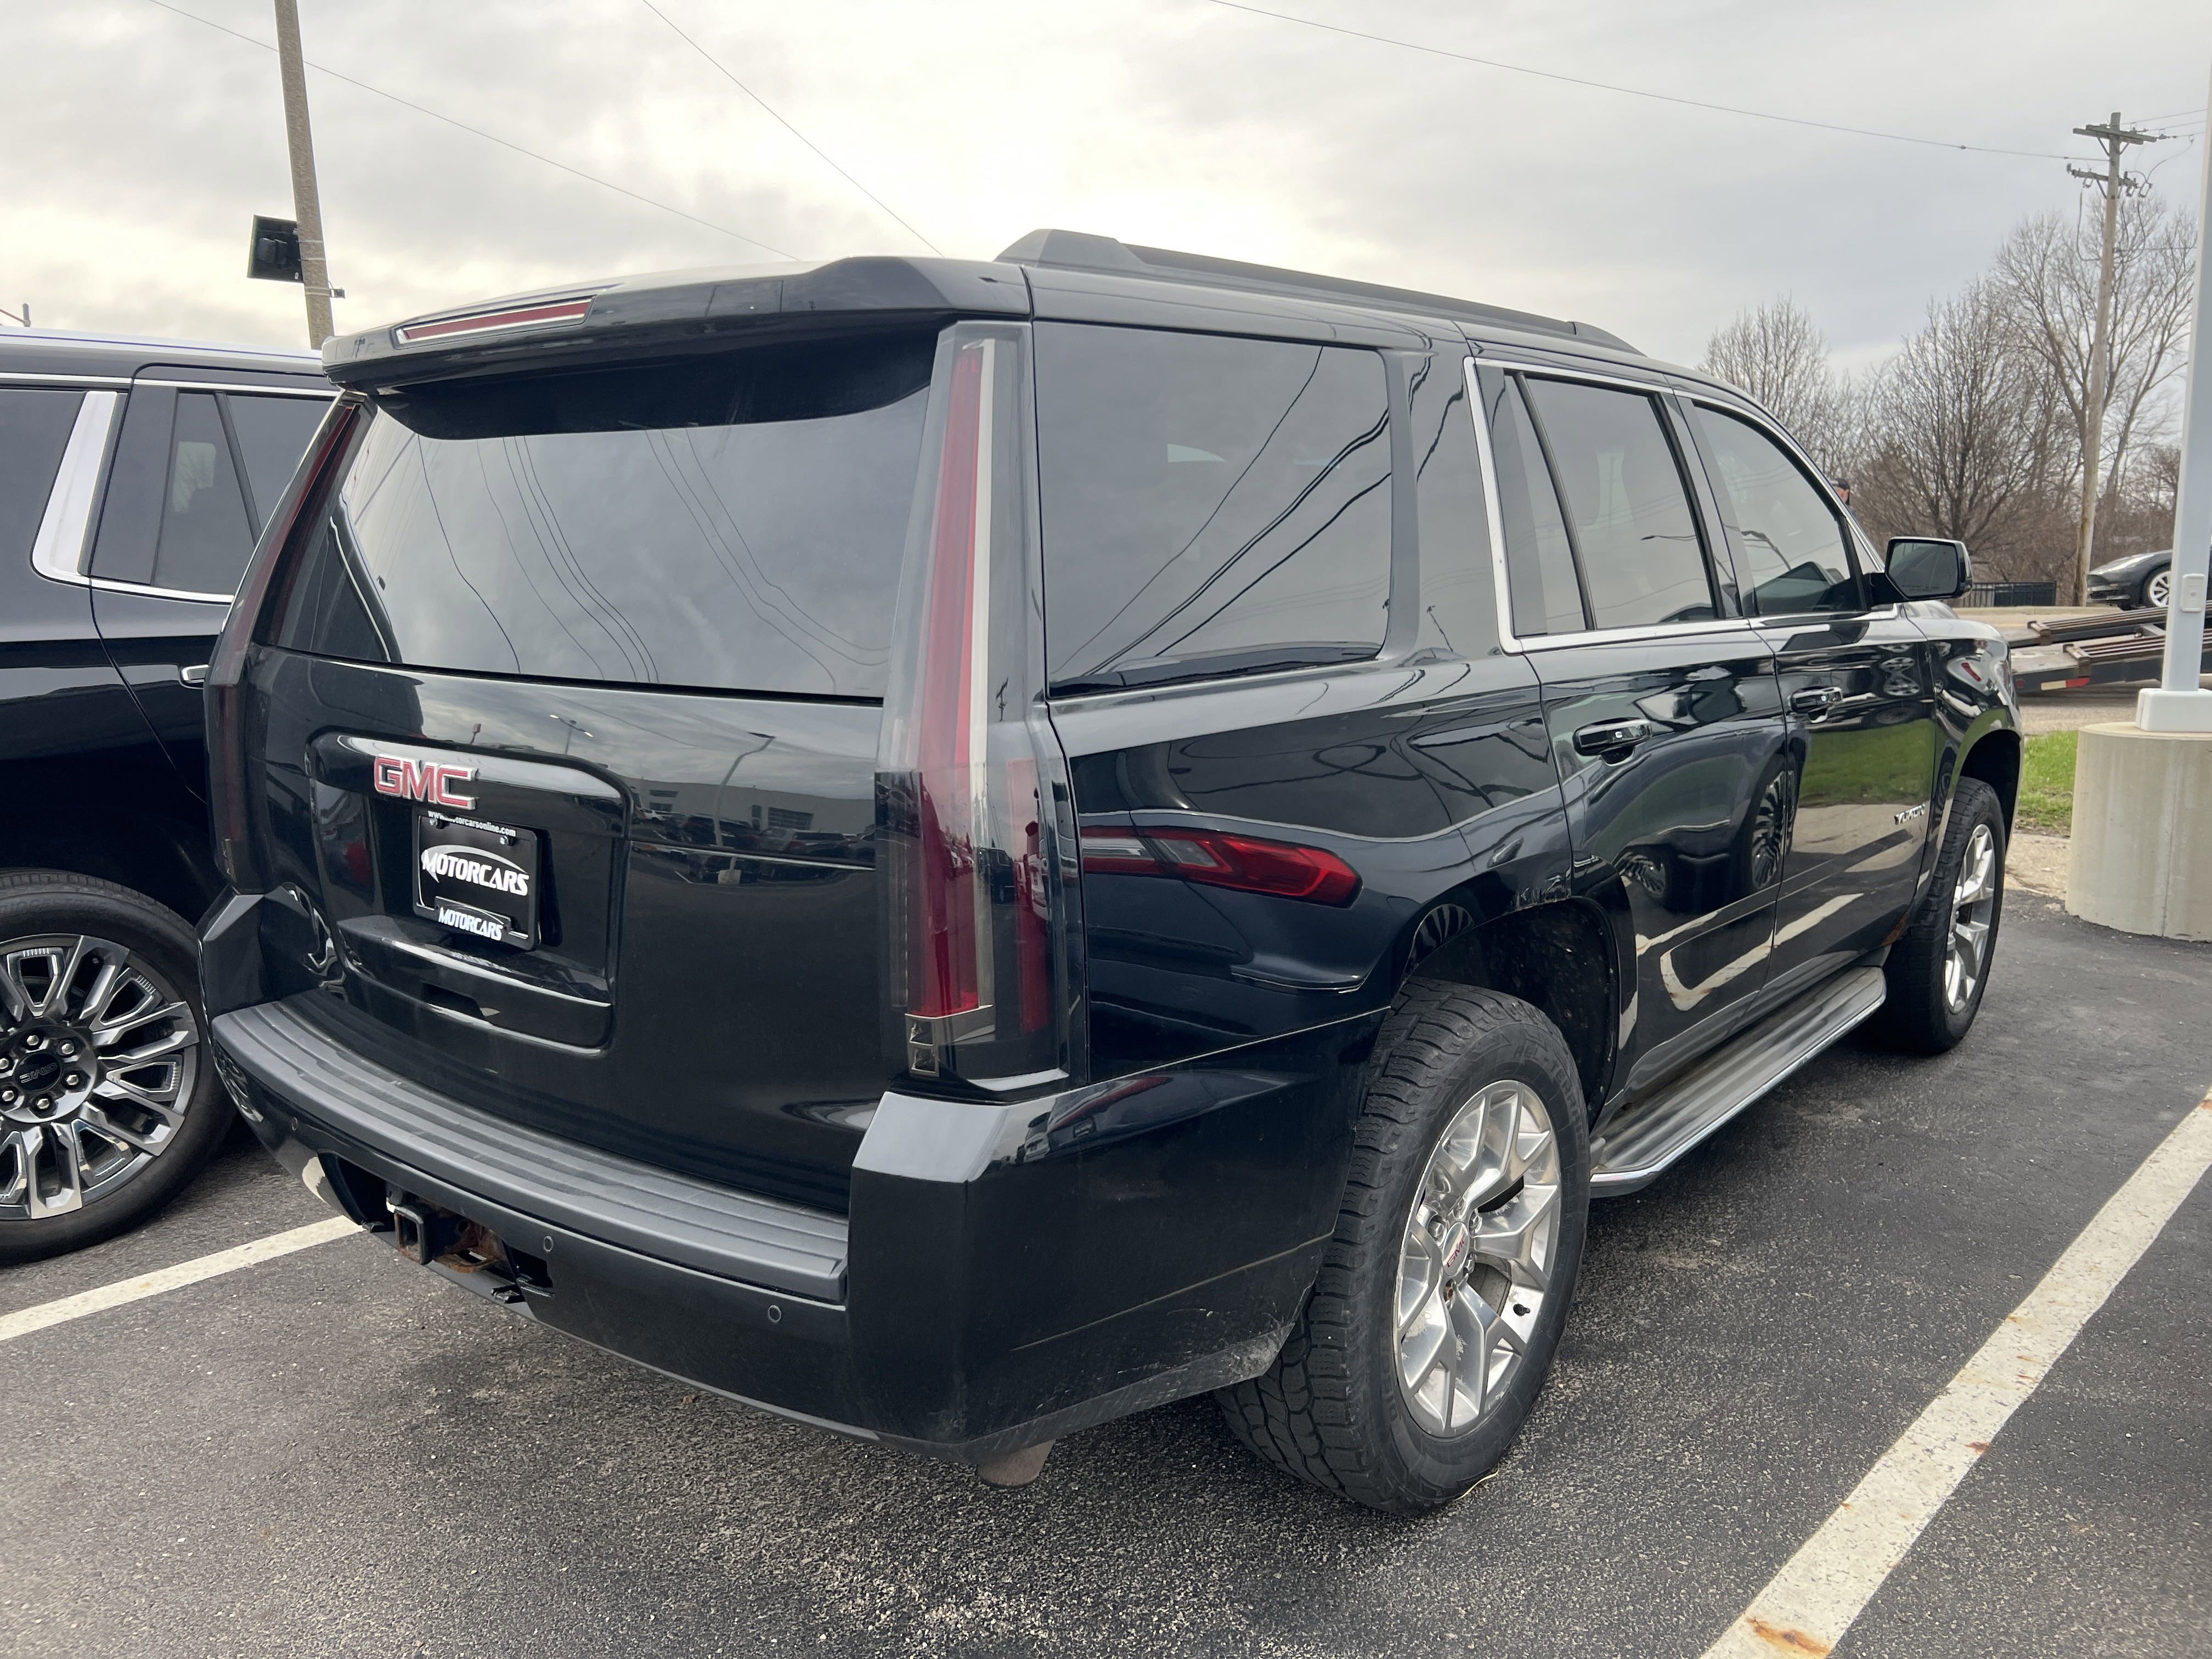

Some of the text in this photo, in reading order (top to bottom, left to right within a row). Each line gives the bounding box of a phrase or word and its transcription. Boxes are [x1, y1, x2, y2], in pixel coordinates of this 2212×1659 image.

[374, 754, 476, 810] GMC
[1894, 804, 1925, 825] YUKON
[422, 849, 529, 896] MOTORCARS
[438, 907, 504, 941] MOTORCARS
[19, 1062, 58, 1084] GMC
[1446, 1232, 1467, 1268] GMC
